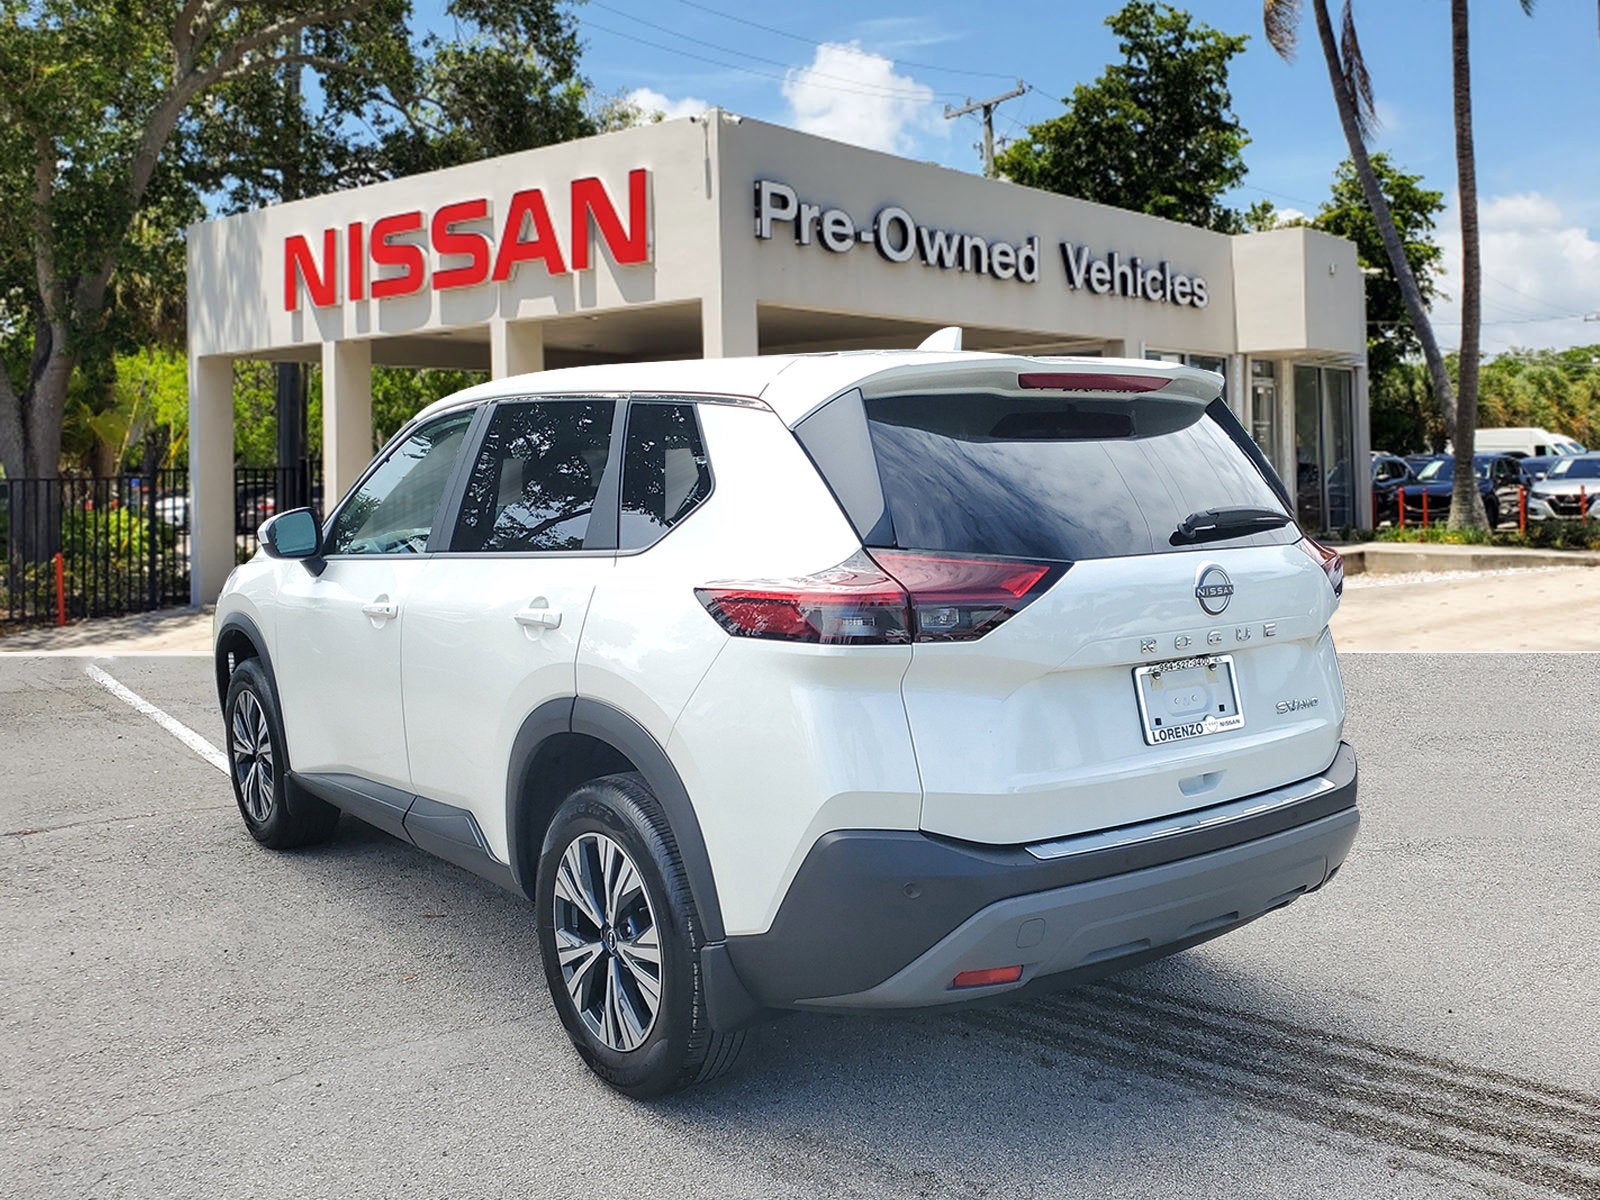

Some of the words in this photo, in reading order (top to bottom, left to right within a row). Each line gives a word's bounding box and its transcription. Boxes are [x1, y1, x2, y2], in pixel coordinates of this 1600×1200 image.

[285, 168, 649, 312] NISSAN
[755, 179, 1040, 284] Pre-Owned
[1060, 241, 1209, 309] Vehicles
[1196, 585, 1234, 597] NISSAN
[1140, 622, 1277, 653] ROGUE
[1275, 699, 1297, 715] SV
[1152, 723, 1204, 742] LORENZO
[1219, 718, 1241, 727] NISSAN
